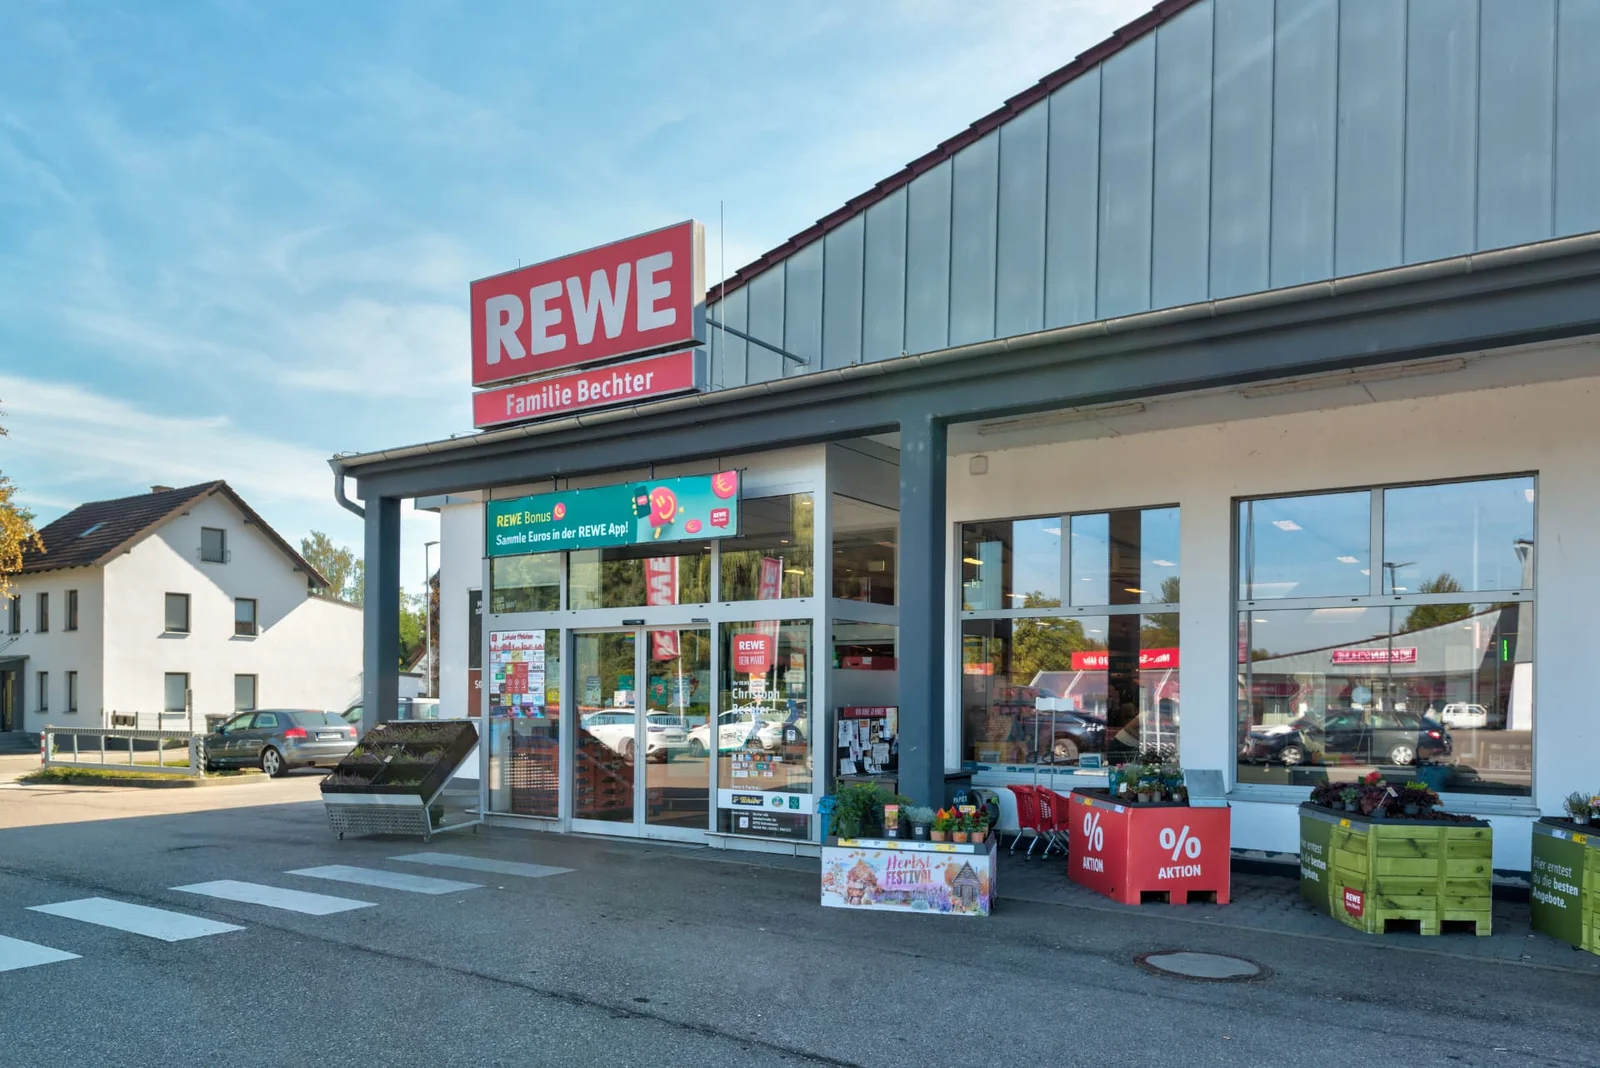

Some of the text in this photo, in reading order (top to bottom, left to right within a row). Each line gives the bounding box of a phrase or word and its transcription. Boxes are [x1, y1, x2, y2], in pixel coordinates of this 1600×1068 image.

[485, 251, 676, 365] REWE
[506, 371, 654, 415] Familie Bechter
[496, 510, 551, 527] REWE Bonus
[496, 521, 629, 546] Sammle Euros in der REWE App!
[739, 640, 765, 650] REWE
[732, 687, 780, 702] Christoph
[1083, 812, 1104, 851] %
[1159, 825, 1202, 862] %
[885, 855, 933, 870] Herbst
[1083, 856, 1104, 873] AKTION
[1158, 864, 1201, 880] AKTION
[1533, 855, 1572, 878] Hier erntest
[885, 869, 934, 885] FESTIVAL
[1533, 873, 1579, 896] du die besten
[1345, 892, 1361, 904] REWE
[1532, 886, 1567, 909] Angebote.
